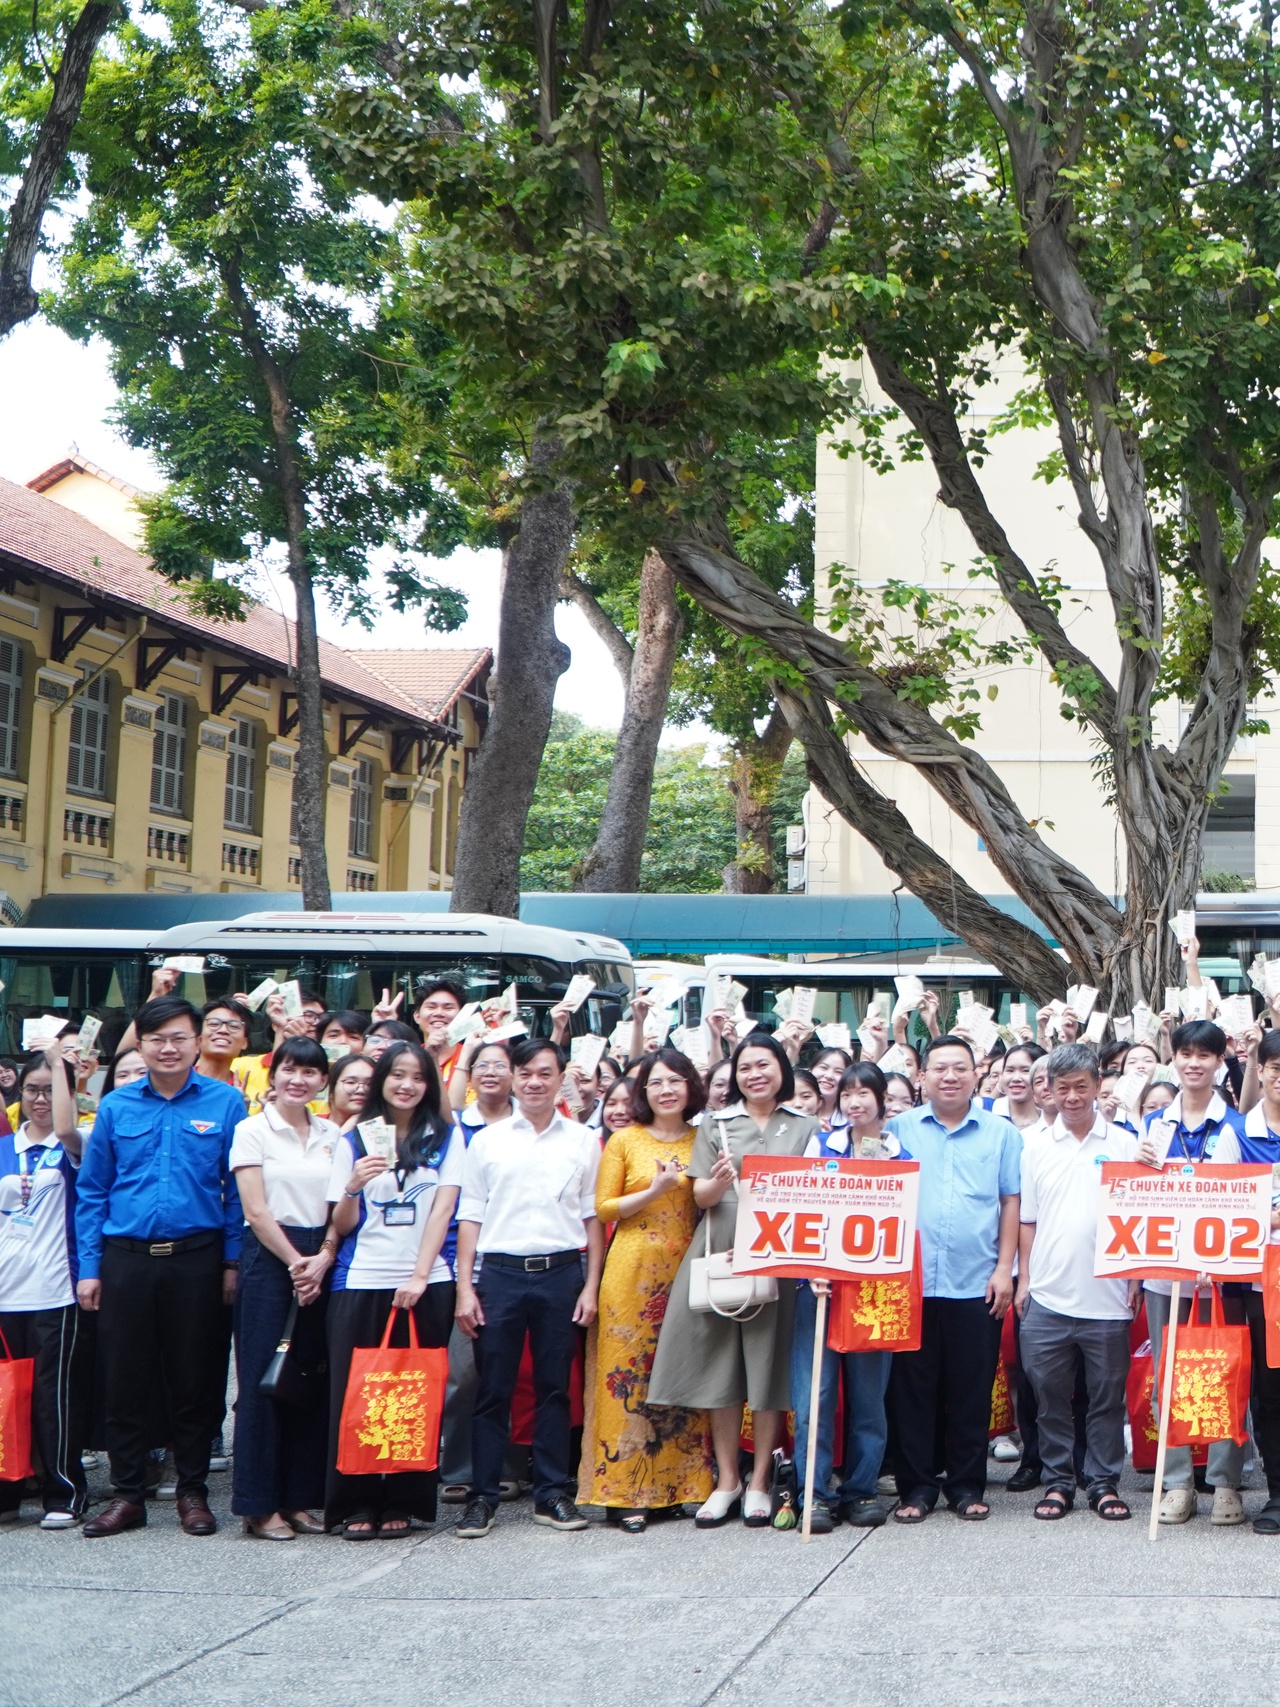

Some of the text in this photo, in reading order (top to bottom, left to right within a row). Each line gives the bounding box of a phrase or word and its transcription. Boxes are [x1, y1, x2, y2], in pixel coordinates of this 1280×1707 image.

[505, 975, 543, 983] SAMCO
[771, 1170, 818, 1189] CHUYẾN
[821, 1176, 836, 1189] XE
[839, 1174, 872, 1190] ĐOÀN
[876, 1176, 903, 1192] VIÊN
[1130, 1175, 1174, 1192] CHUYẾN
[1177, 1181, 1192, 1193] XE
[1195, 1178, 1227, 1193] ĐOÀN
[1231, 1179, 1257, 1194] VIÊN
[750, 1211, 899, 1257] XE 01
[1104, 1215, 1260, 1258] XE 02
